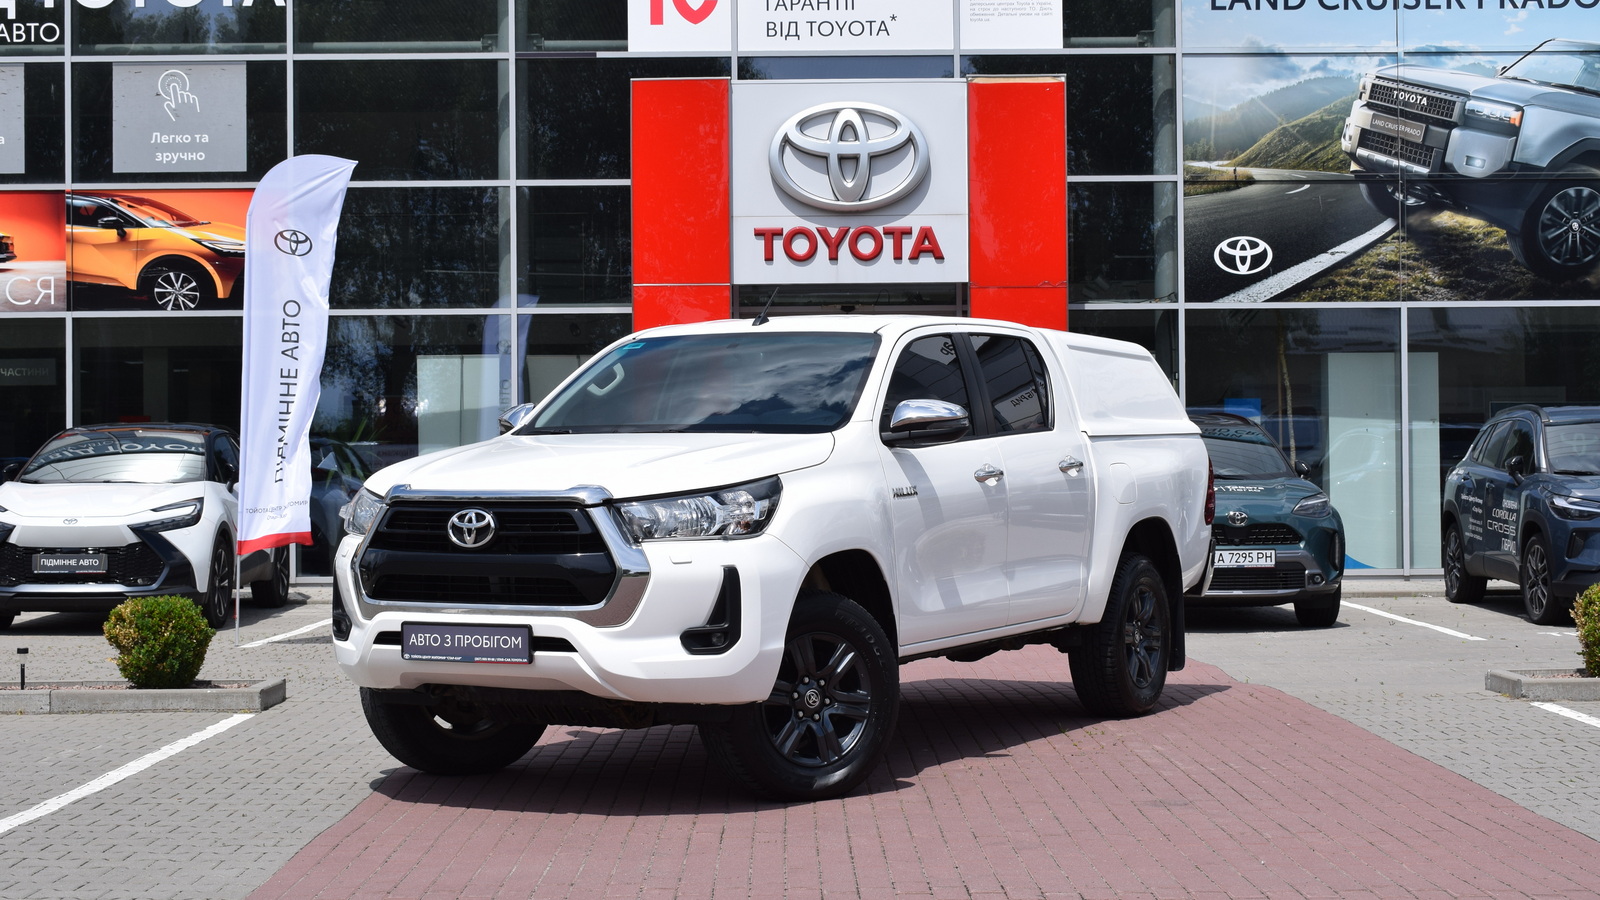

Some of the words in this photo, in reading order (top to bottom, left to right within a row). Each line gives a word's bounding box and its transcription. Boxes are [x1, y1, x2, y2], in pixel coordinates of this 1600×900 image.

[766, 21, 800, 40] ВІД
[1393, 90, 1427, 105] TOYOTA
[1372, 118, 1385, 128] LAND
[150, 132, 190, 146] Легко
[195, 133, 209, 144] та
[155, 150, 206, 164] зручно
[754, 225, 945, 262] TOYOTA
[280, 299, 301, 361] АВТО
[1492, 508, 1516, 521] COROLLA
[1487, 520, 1516, 536] CROSS
[40, 559, 77, 567] ПІДМІННЕ
[1228, 552, 1254, 563] 7295
[1257, 552, 1273, 563] PH
[409, 633, 441, 647] АВТО
[455, 635, 522, 648] ПРОБІГОМ
